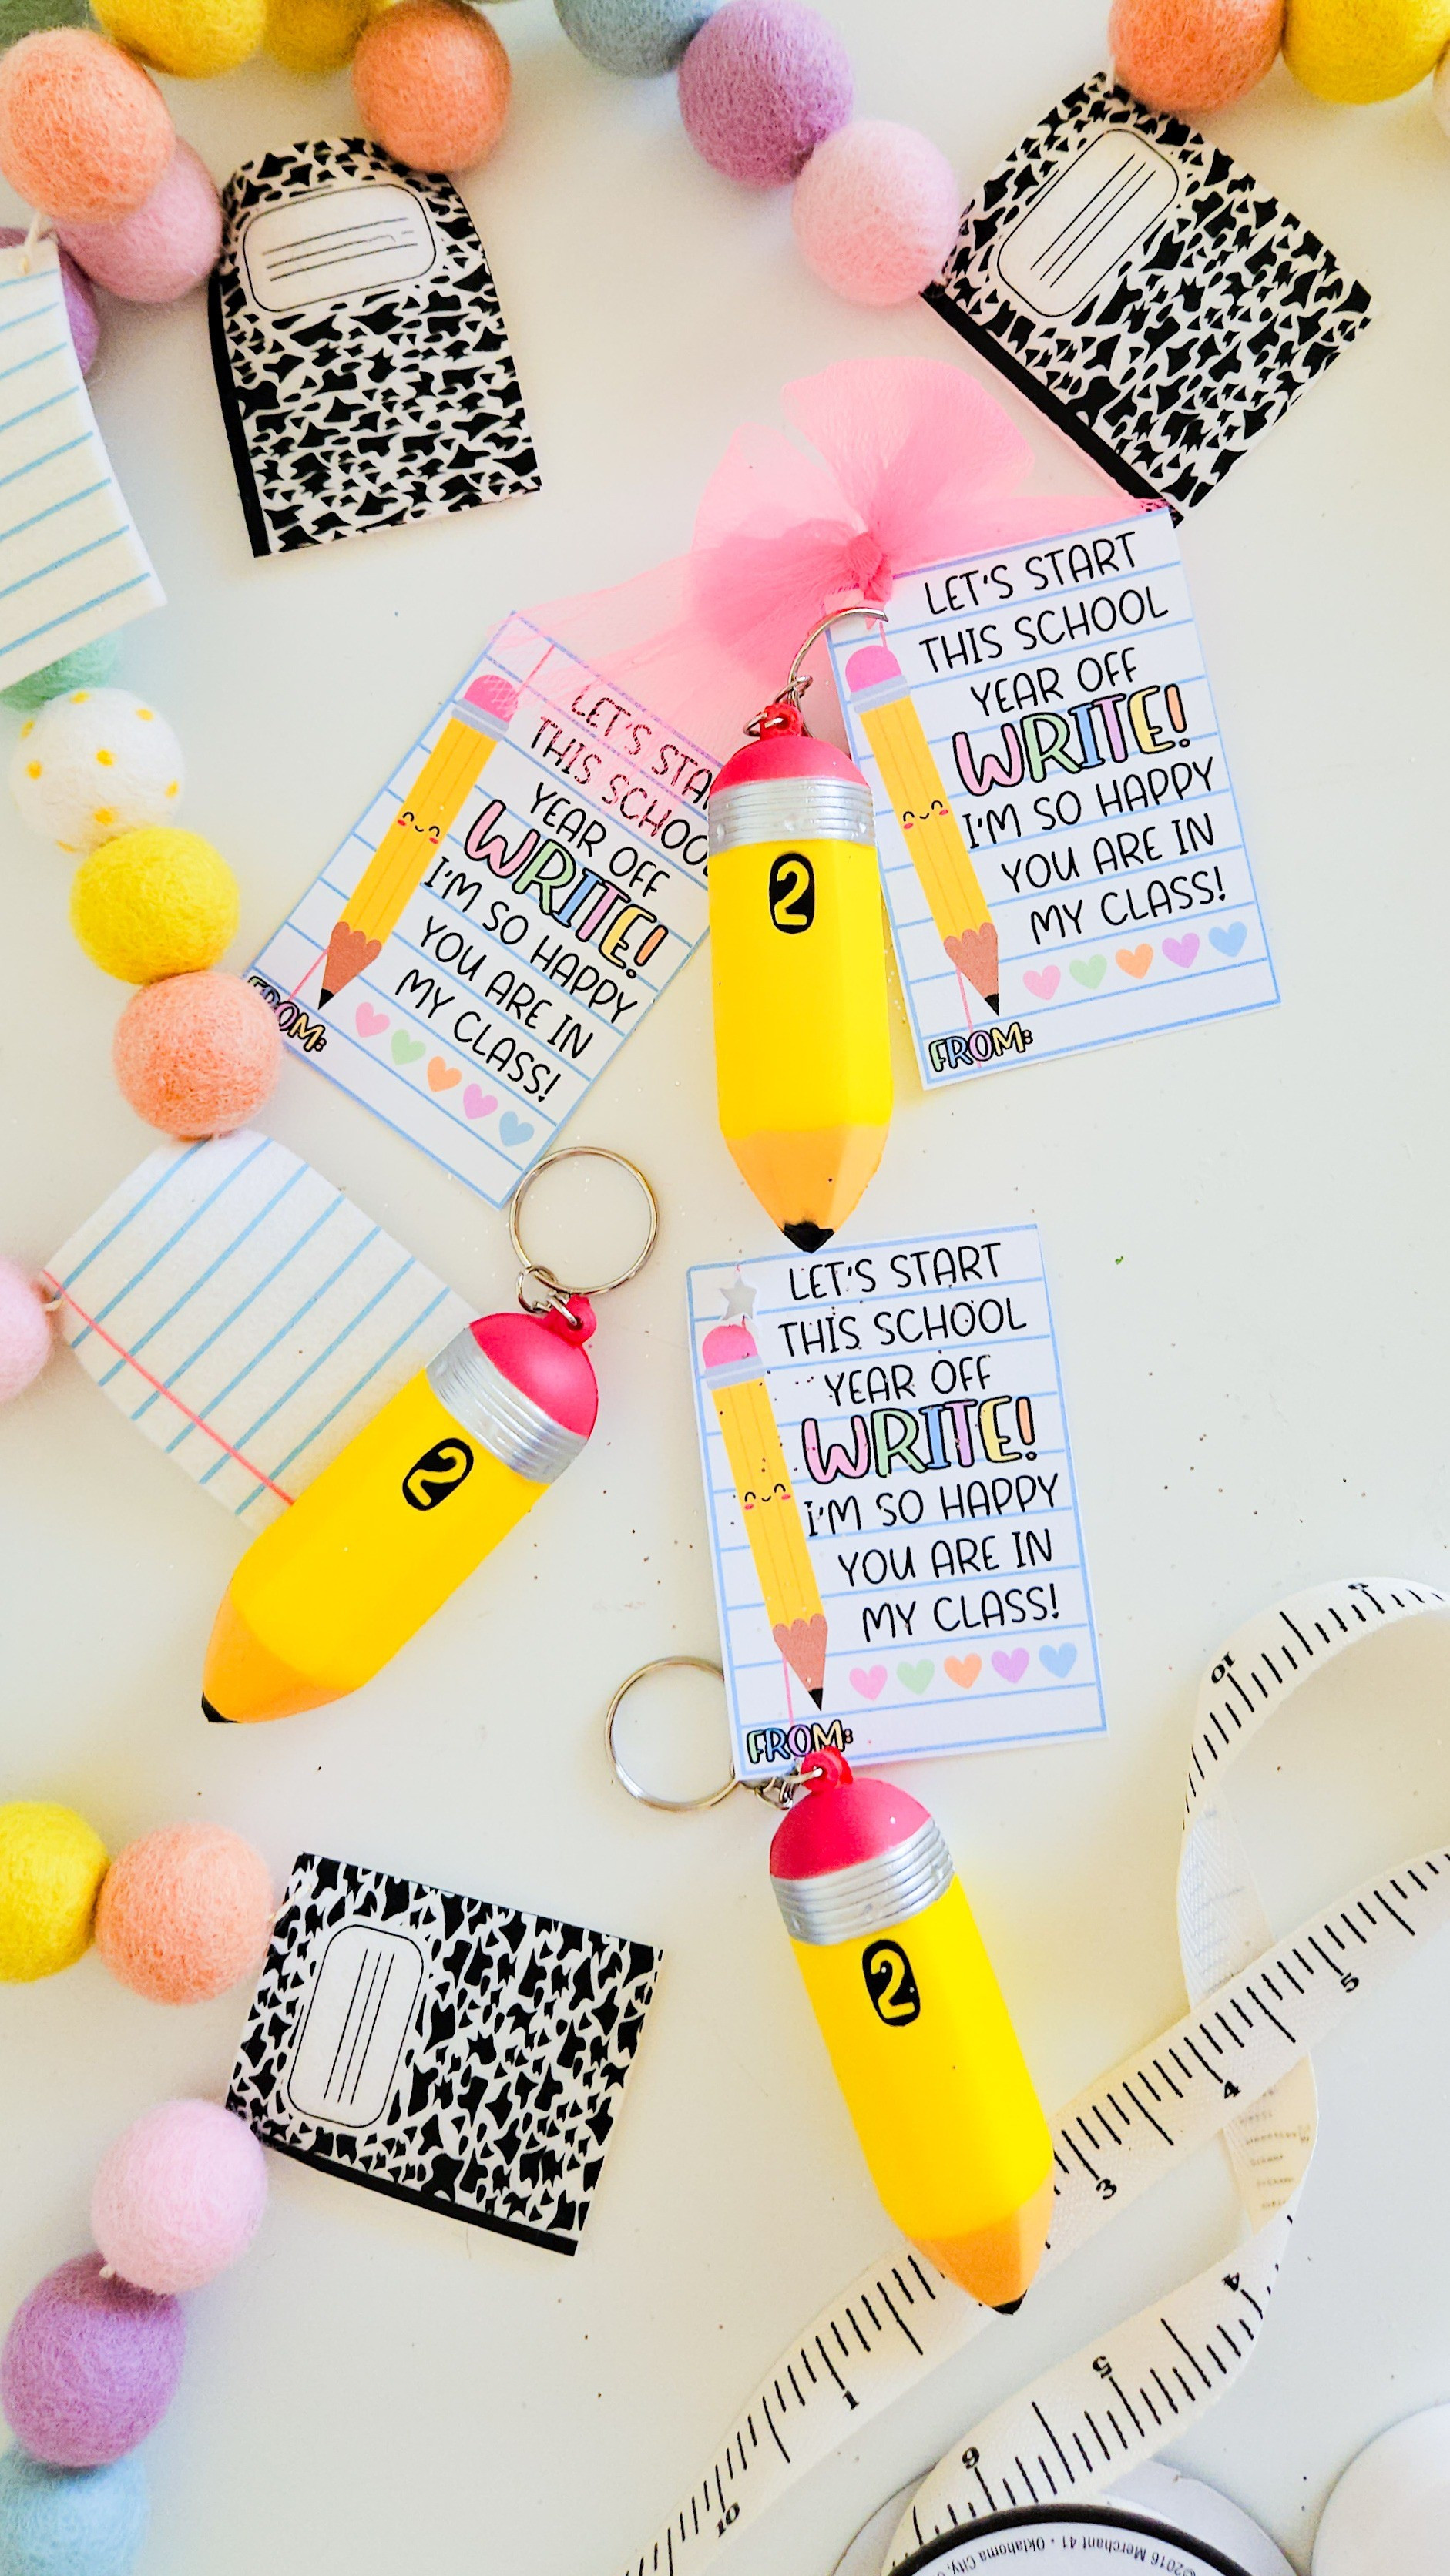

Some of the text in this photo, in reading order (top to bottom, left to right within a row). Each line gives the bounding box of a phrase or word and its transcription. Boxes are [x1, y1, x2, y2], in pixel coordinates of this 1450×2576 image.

[924, 531, 1136, 615] LET'S START
[918, 585, 1169, 673] THIS SCHOOL
[970, 646, 1136, 717] YEAR OFF
[571, 683, 713, 804] LET'S STA
[952, 683, 1191, 797] WRITE!
[531, 716, 709, 877] THIS SCHOO
[962, 756, 1213, 850] I'M SO HAPPY
[530, 782, 670, 897] YEAR OFF
[1001, 813, 1214, 894] YOU ARE IN
[463, 799, 670, 979] WRITE!
[774, 860, 810, 926] 2
[1030, 865, 1226, 945] MY CLASS!
[423, 856, 638, 1024] I'M SO HAPPY
[420, 915, 594, 1059] YOU ARE IN
[394, 968, 562, 1102] MY CLASS!
[928, 1021, 1034, 1072] FROM:
[789, 1242, 1001, 1301] LET'S START
[777, 1297, 1027, 1357] THIS SCHOOL
[824, 1354, 991, 1407] YEAR OFF
[801, 1394, 1038, 1485] WRITE!
[407, 1446, 468, 1507] 2
[804, 1472, 1059, 1538] I'M SO HAPPY
[837, 1528, 1052, 1587] YOU ARE IN
[862, 1582, 1059, 1642] MY CLASS!
[1210, 1651, 1235, 1684] 10
[747, 1719, 854, 1764] FROM:
[870, 1947, 915, 2020] 2
[1340, 1971, 1360, 1993] 5
[1223, 2080, 1242, 2099] 4
[1096, 2178, 1118, 2201] 3
[1220, 2272, 1240, 2293] 4
[1091, 2354, 1113, 2379] 5
[841, 2390, 861, 2410] 1
[716, 2501, 740, 2538] 10
[978, 2535, 1046, 2563] Oklahoma
[1062, 2535, 1077, 2550] 41
[1082, 2535, 1147, 2561] Merchant
[947, 2555, 977, 2575] City,
